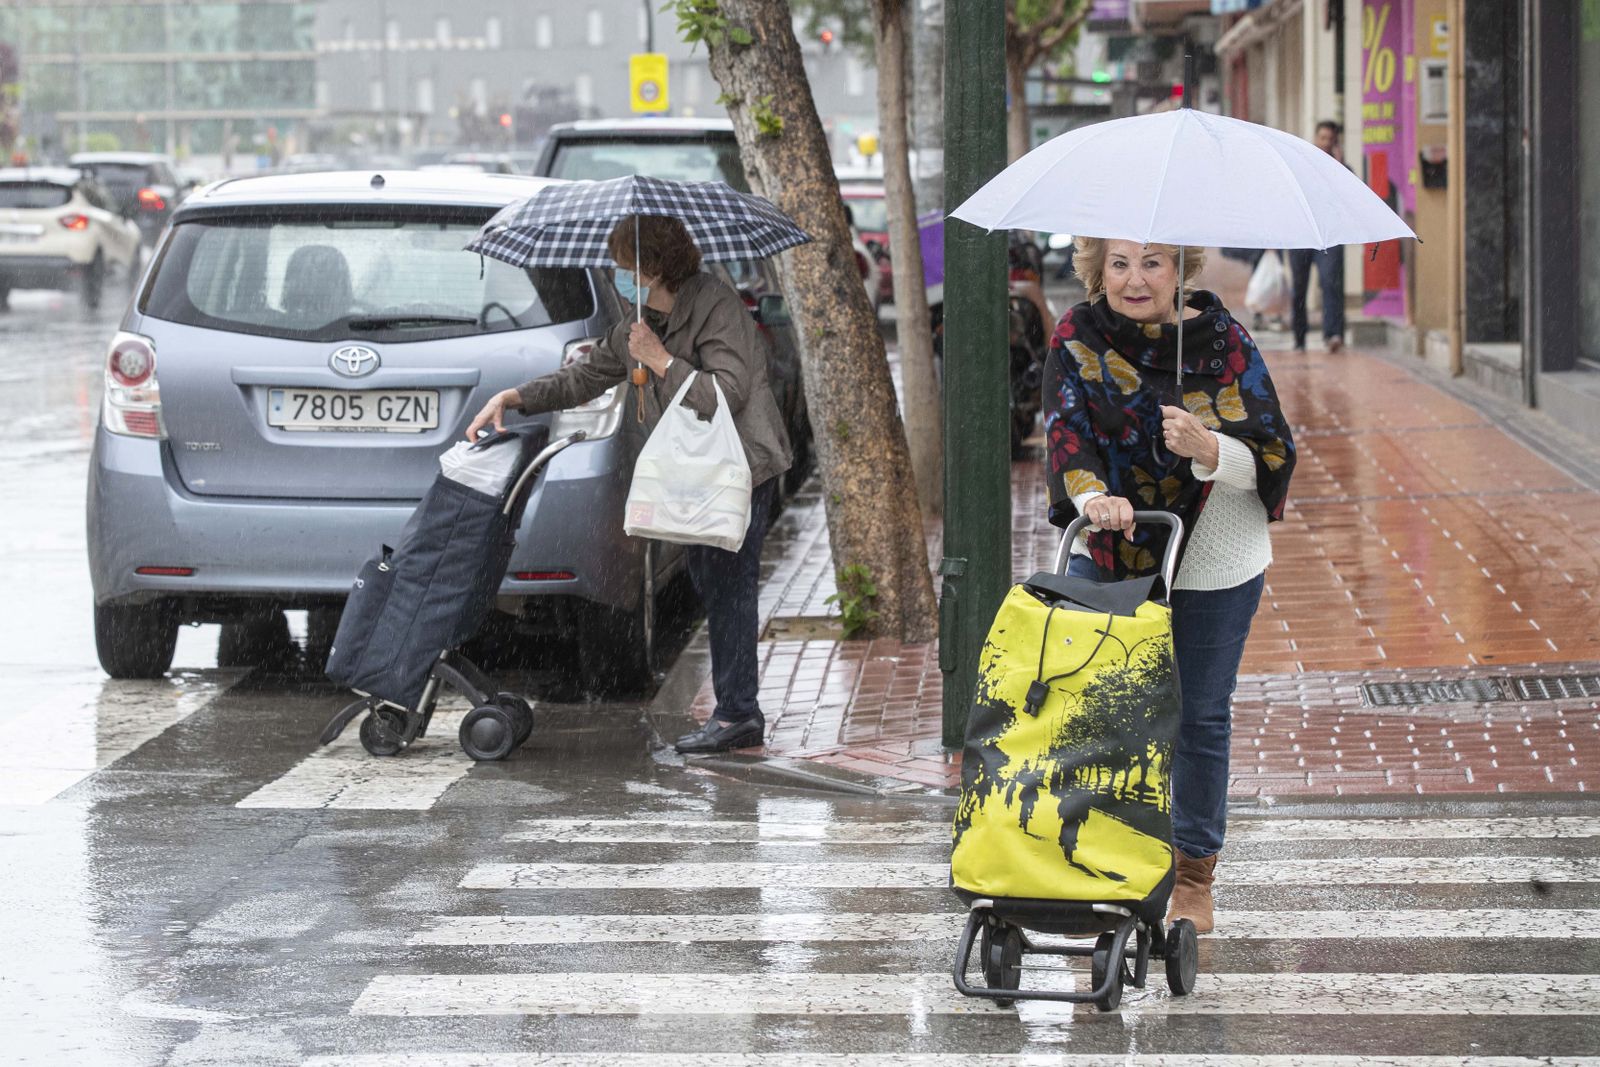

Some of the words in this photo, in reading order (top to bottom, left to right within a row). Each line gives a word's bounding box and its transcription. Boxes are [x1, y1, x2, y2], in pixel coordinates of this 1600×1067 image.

[293, 394, 364, 421] 7805
[377, 396, 430, 422] GZN
[184, 441, 222, 451] TOYOTA
